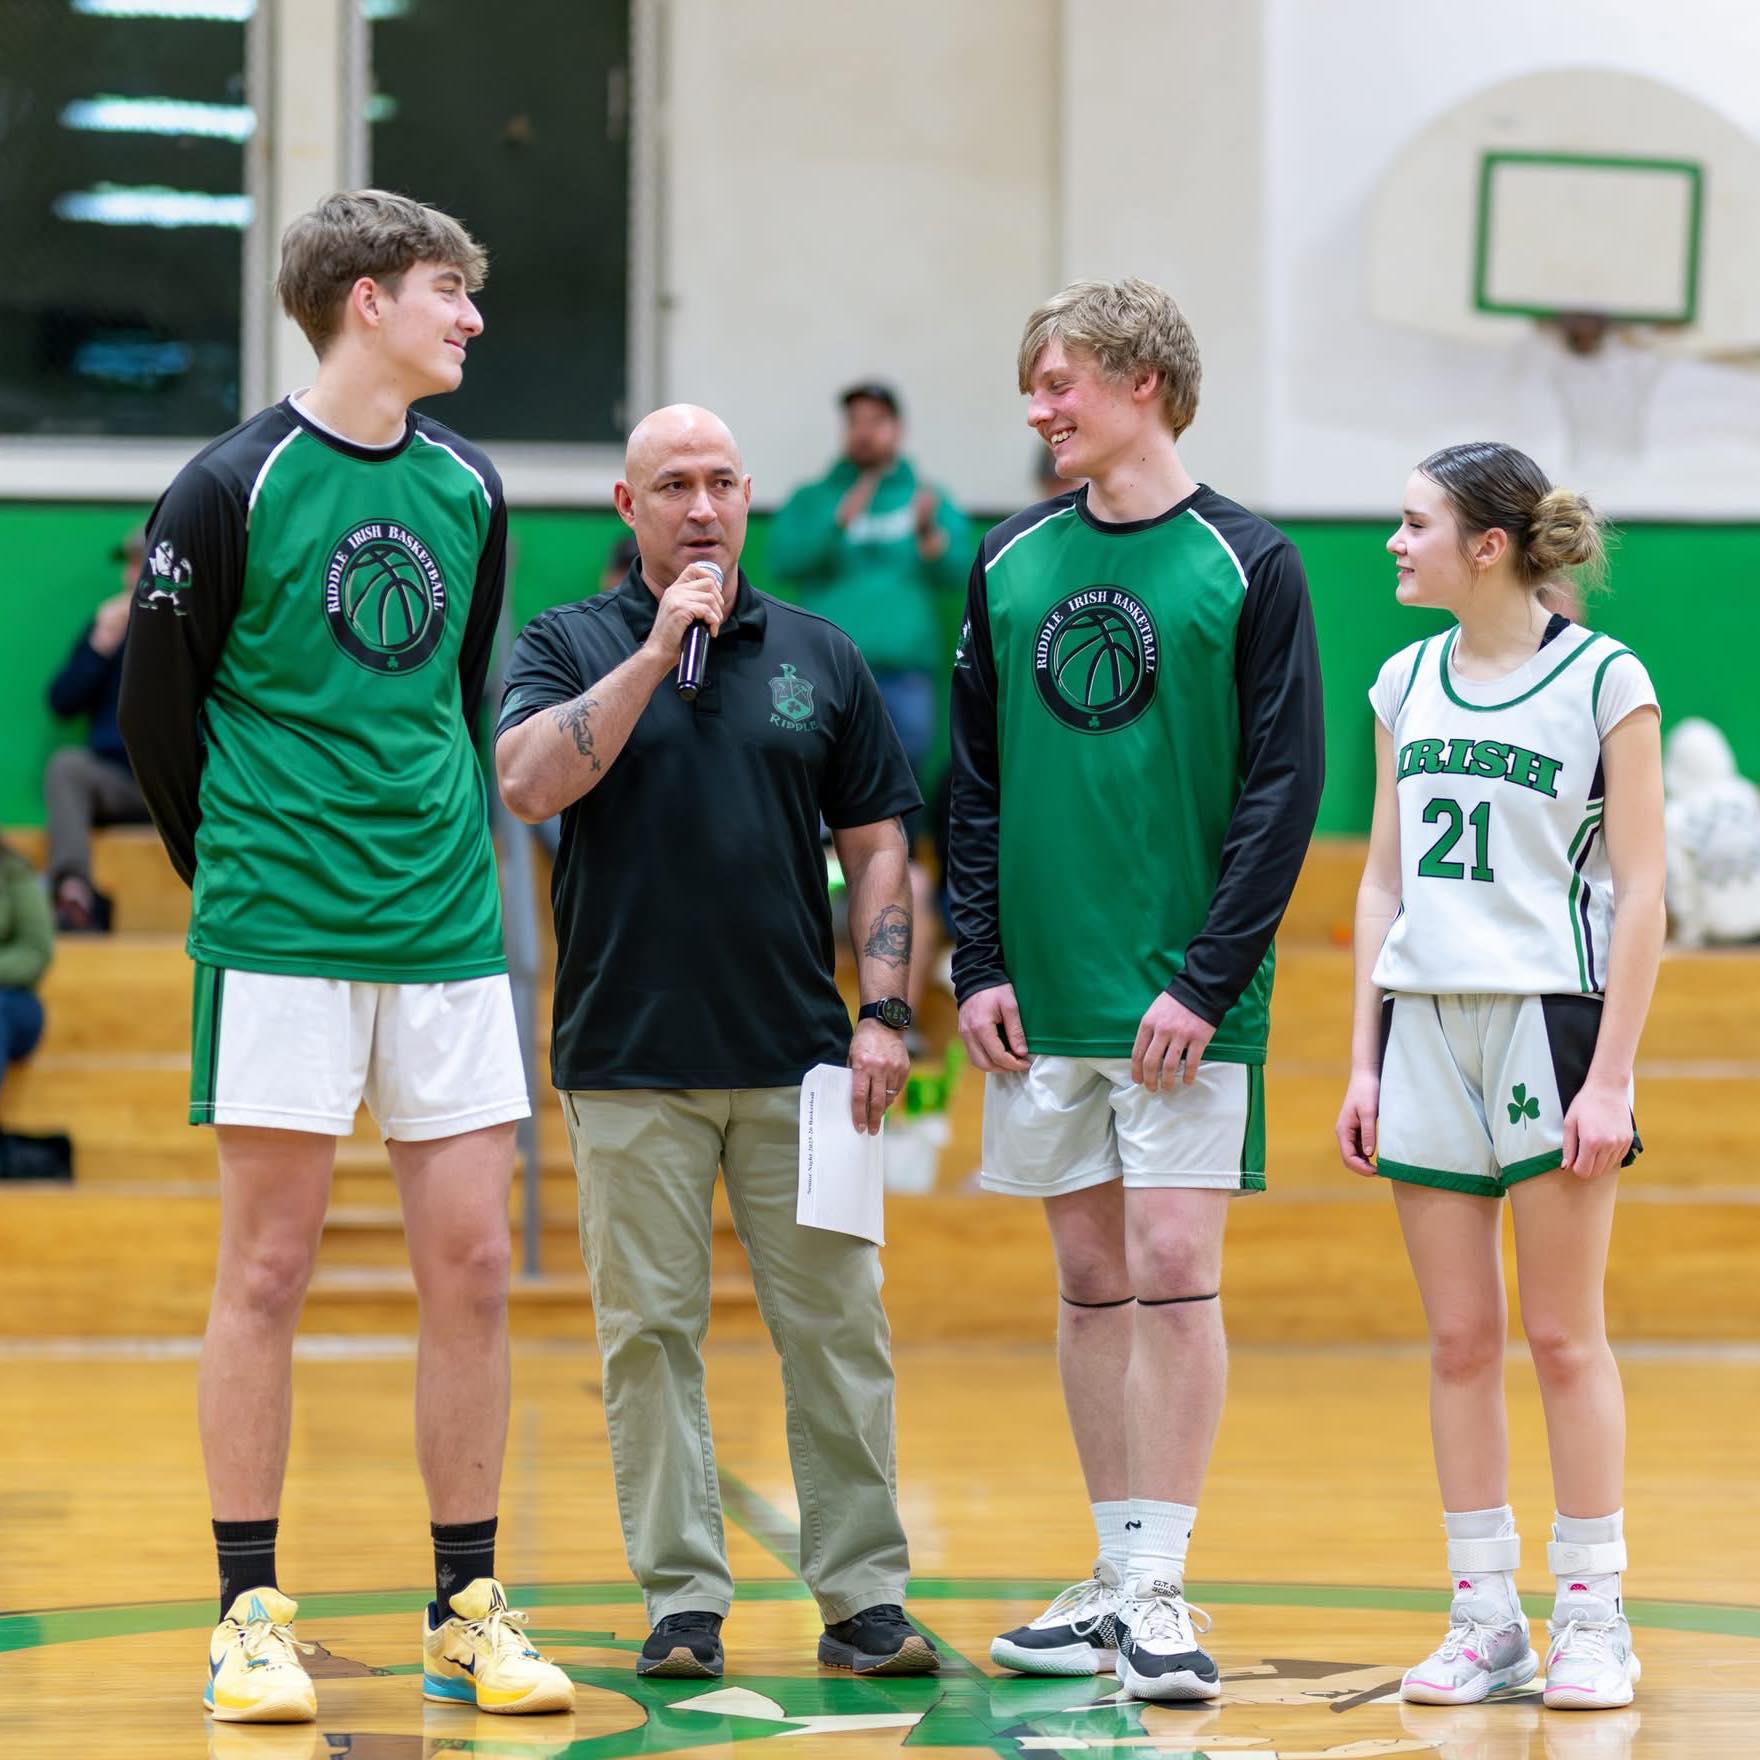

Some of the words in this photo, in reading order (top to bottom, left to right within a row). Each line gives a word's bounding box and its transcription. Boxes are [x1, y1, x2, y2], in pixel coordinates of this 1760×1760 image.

[327, 551, 349, 614] RIDDLE
[347, 525, 383, 549] IRISH
[388, 525, 444, 611] BASKETBALL
[1036, 611, 1064, 670] RIDDLE
[1068, 590, 1108, 612] IRISH
[1112, 593, 1156, 674] BASKETBALL
[1396, 738, 1563, 799] IRISH
[1418, 797, 1494, 883] 21
